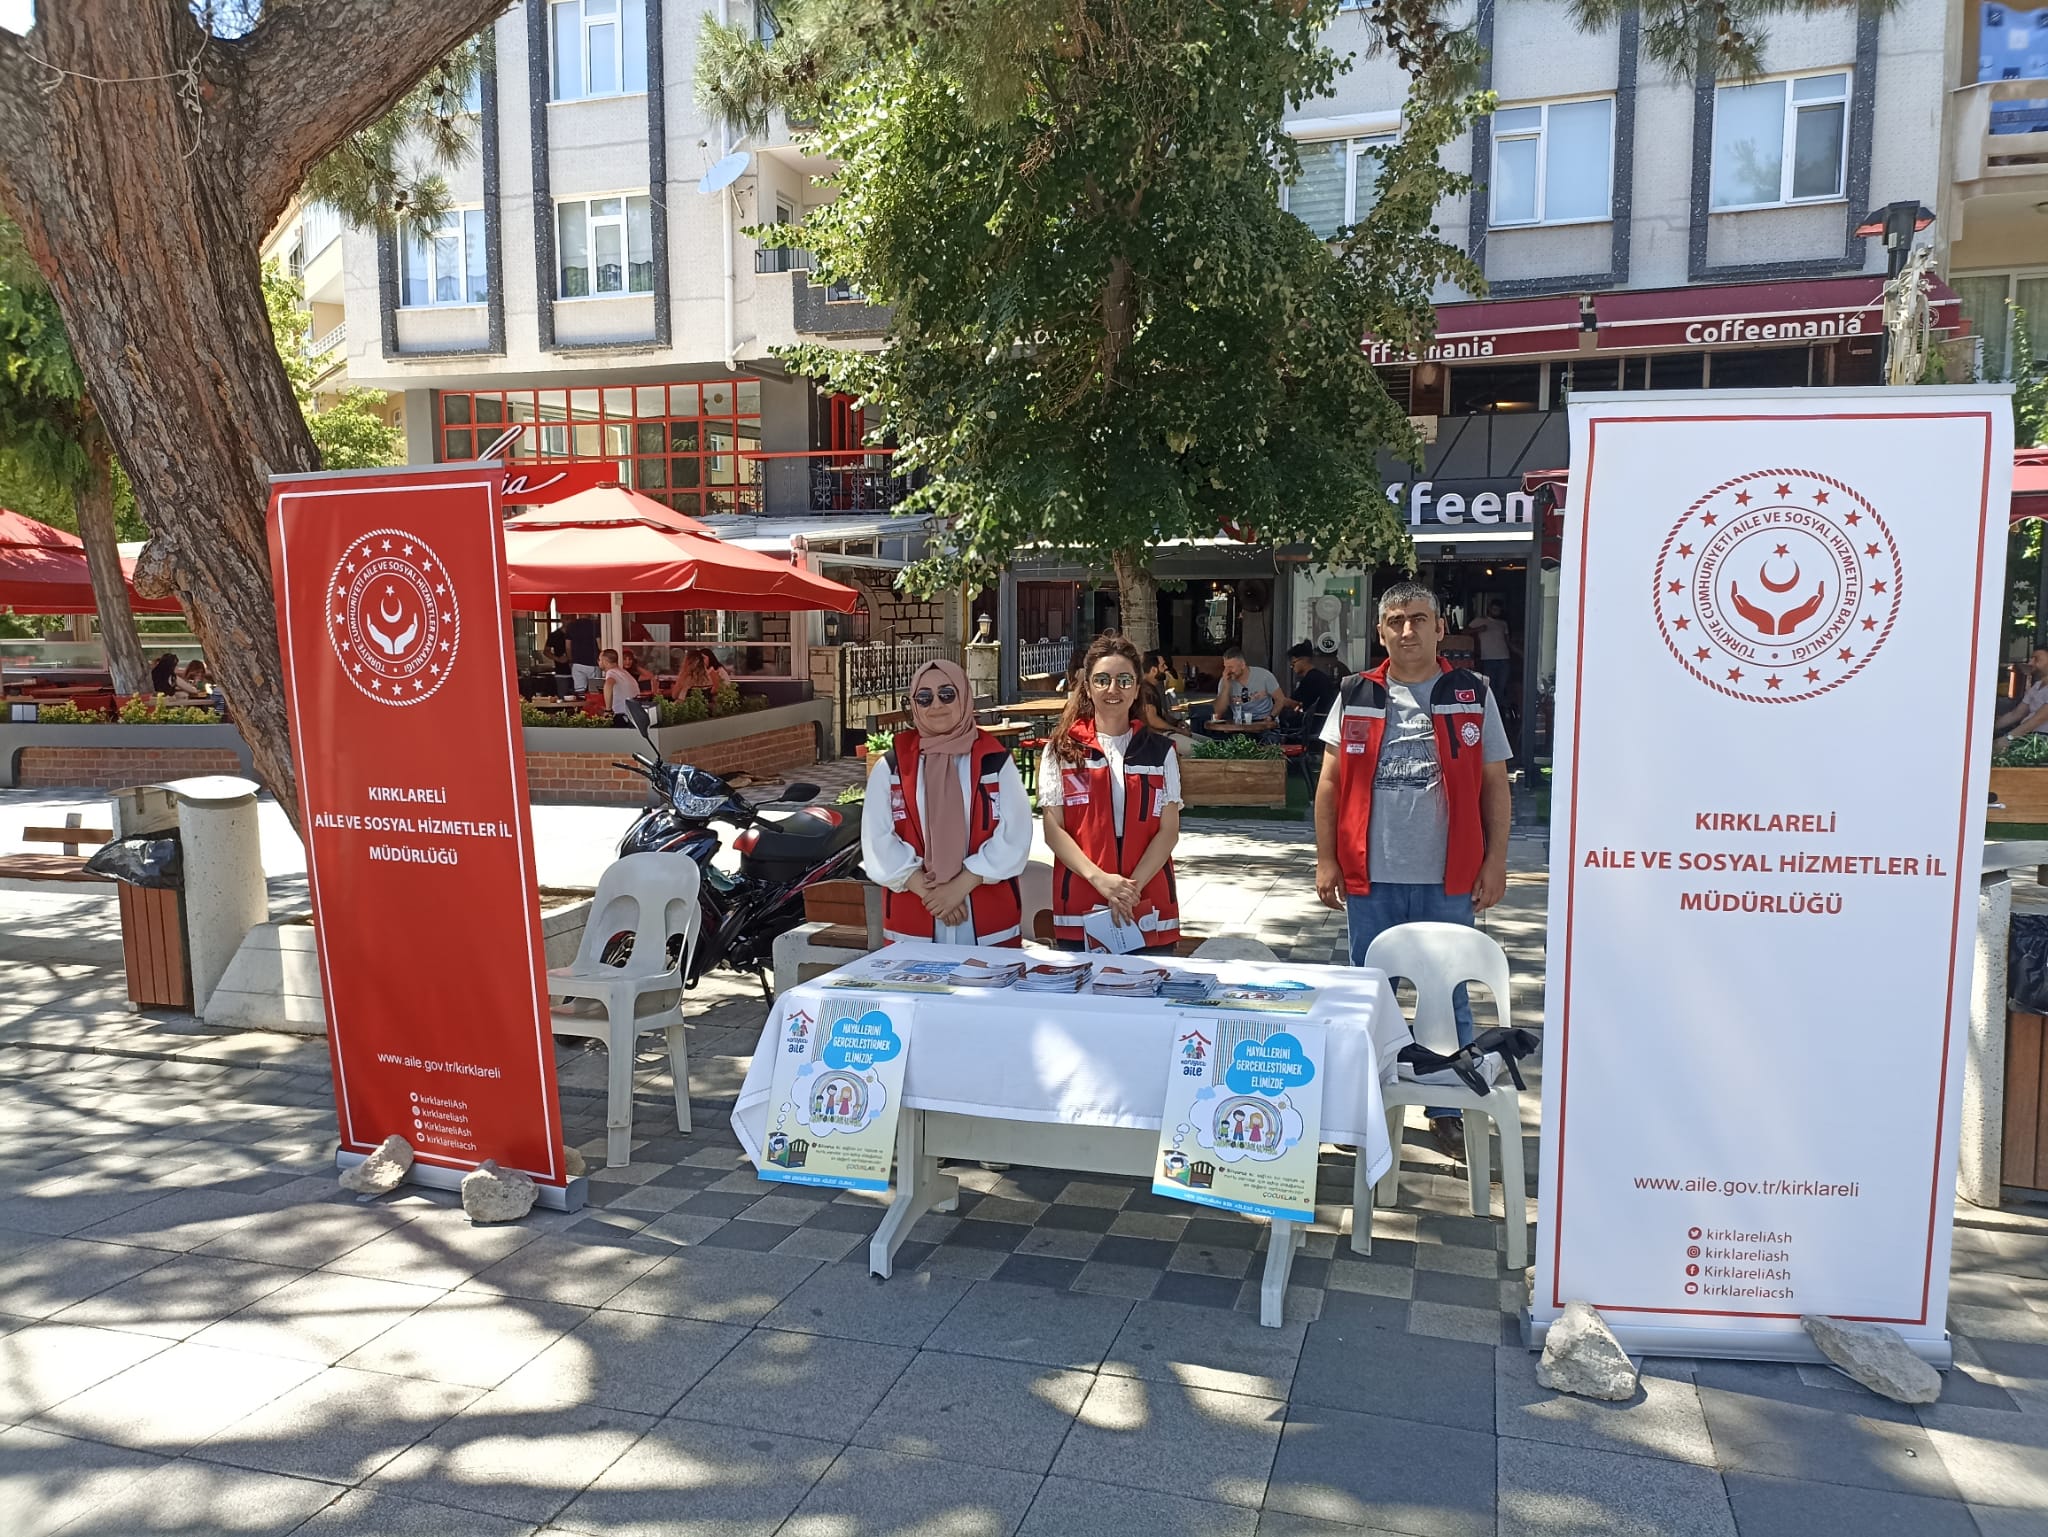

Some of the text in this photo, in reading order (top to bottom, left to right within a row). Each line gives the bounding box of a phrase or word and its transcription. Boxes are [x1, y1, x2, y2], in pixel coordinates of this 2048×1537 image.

[1685, 313, 1862, 343] Coffeemania
[1698, 511, 1857, 660] TÜRKİYE CUMHURİYETİ AİLE VE SOSYAL HİZMETLER BAKANLIĞI
[350, 560, 437, 673] TÜRKİYE CUMHURİYETİ AİLE VE SOSYAL HİZMETLER BAKANLIĞI
[368, 786, 446, 804] KIRKLARELİ
[315, 811, 513, 838] AİLE VE SOSYAL HİZMETLER İL
[1695, 811, 1837, 833] KIRKLARELİ
[369, 844, 458, 865] MÜDÜRLÜĞÜ
[1584, 846, 1947, 876] AİLE VE SOSYAL HİZMETLER İL
[1680, 889, 1843, 915] MÜDÜRLÜĞÜ
[842, 1023, 882, 1036] HAYALLERİNİ
[844, 1050, 874, 1065] ELİMİZDE
[1246, 1044, 1291, 1059] HAYALLERİNİ
[377, 1053, 502, 1078] www.aile.gov.tr/kirklareli
[1183, 1065, 1203, 1077] aile
[1251, 1075, 1285, 1090] ELİMİZDE
[420, 1095, 468, 1110] kirklareliAsh
[421, 1108, 469, 1123] kirklareliash
[424, 1122, 472, 1137] KirklareliAsh
[1633, 1176, 1860, 1197] www.aile.gov.tr/kirklareli
[1706, 1228, 1793, 1244] kirklareliAsh
[1705, 1246, 1790, 1262] kirklareliash
[1704, 1265, 1791, 1281] KirklareliAsh
[1703, 1283, 1794, 1299] kirklareliacsh
